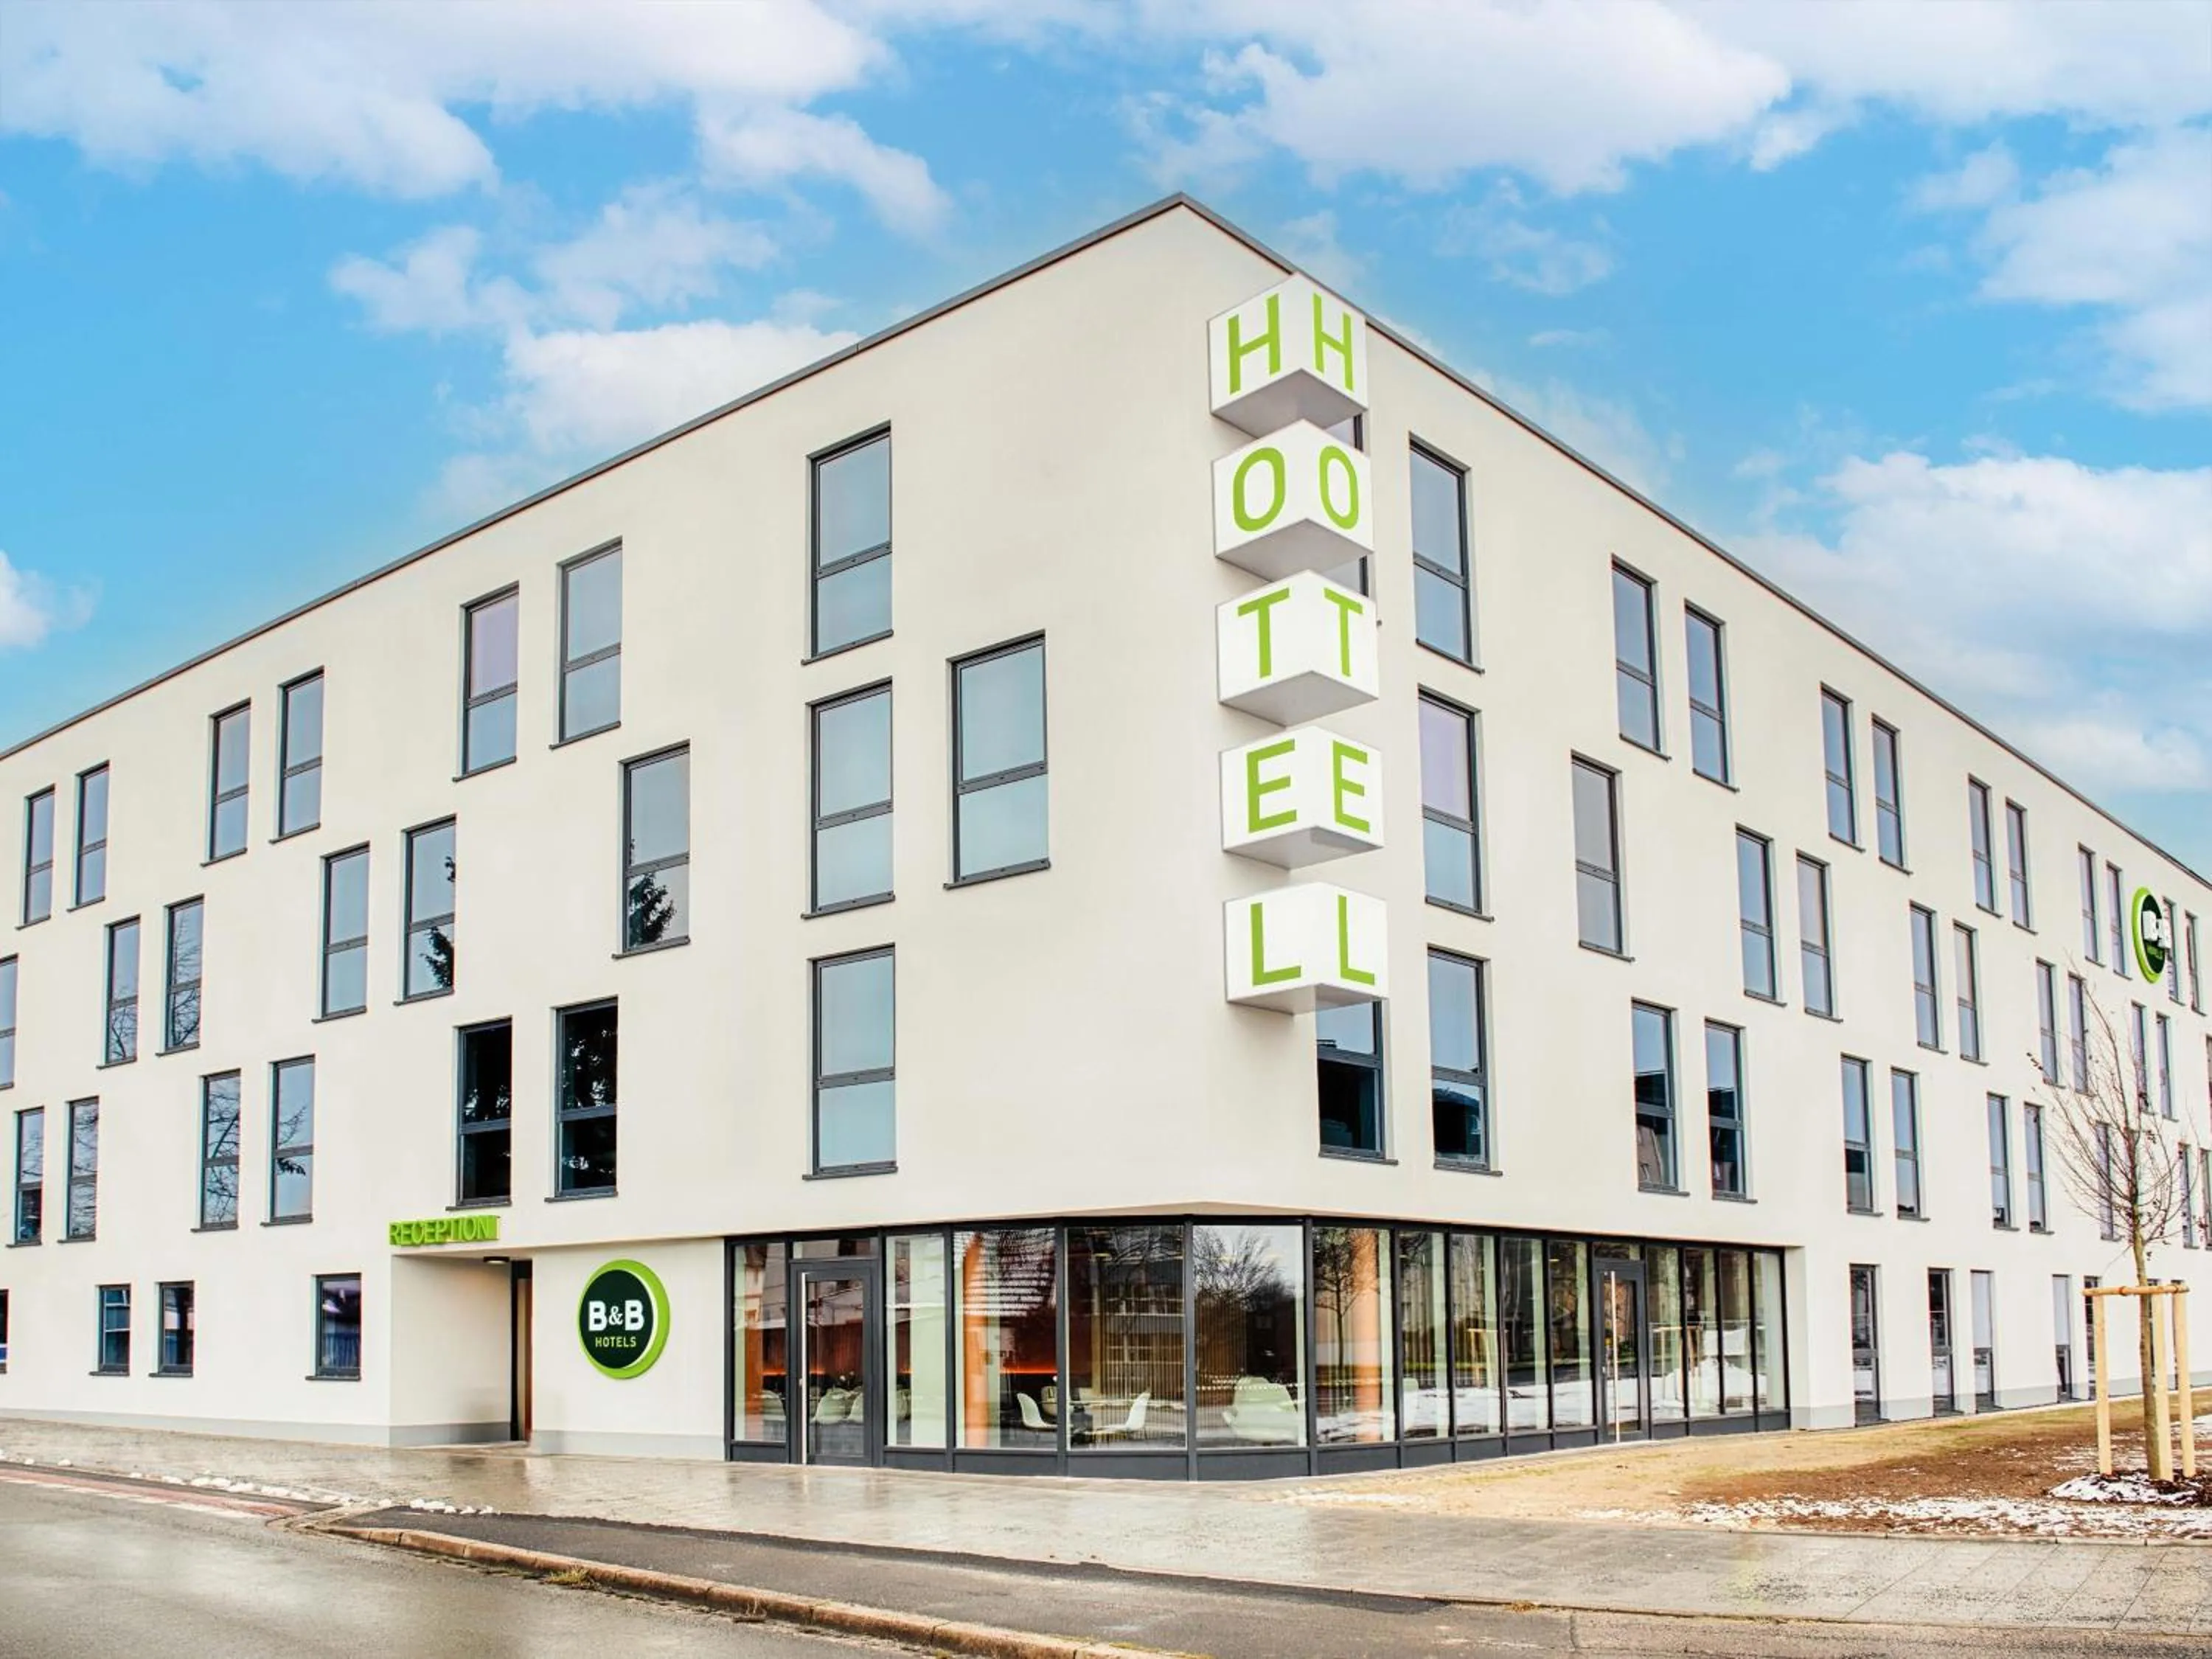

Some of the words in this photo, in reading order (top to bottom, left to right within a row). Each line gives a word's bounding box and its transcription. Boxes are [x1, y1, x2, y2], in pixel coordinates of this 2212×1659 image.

[1227, 293, 1302, 987] HOTEL
[1312, 293, 1377, 987] HOTEL
[389, 1215, 499, 1246] RECEPTION
[588, 1299, 645, 1331] B&B
[595, 1336, 636, 1348] HOTELS
